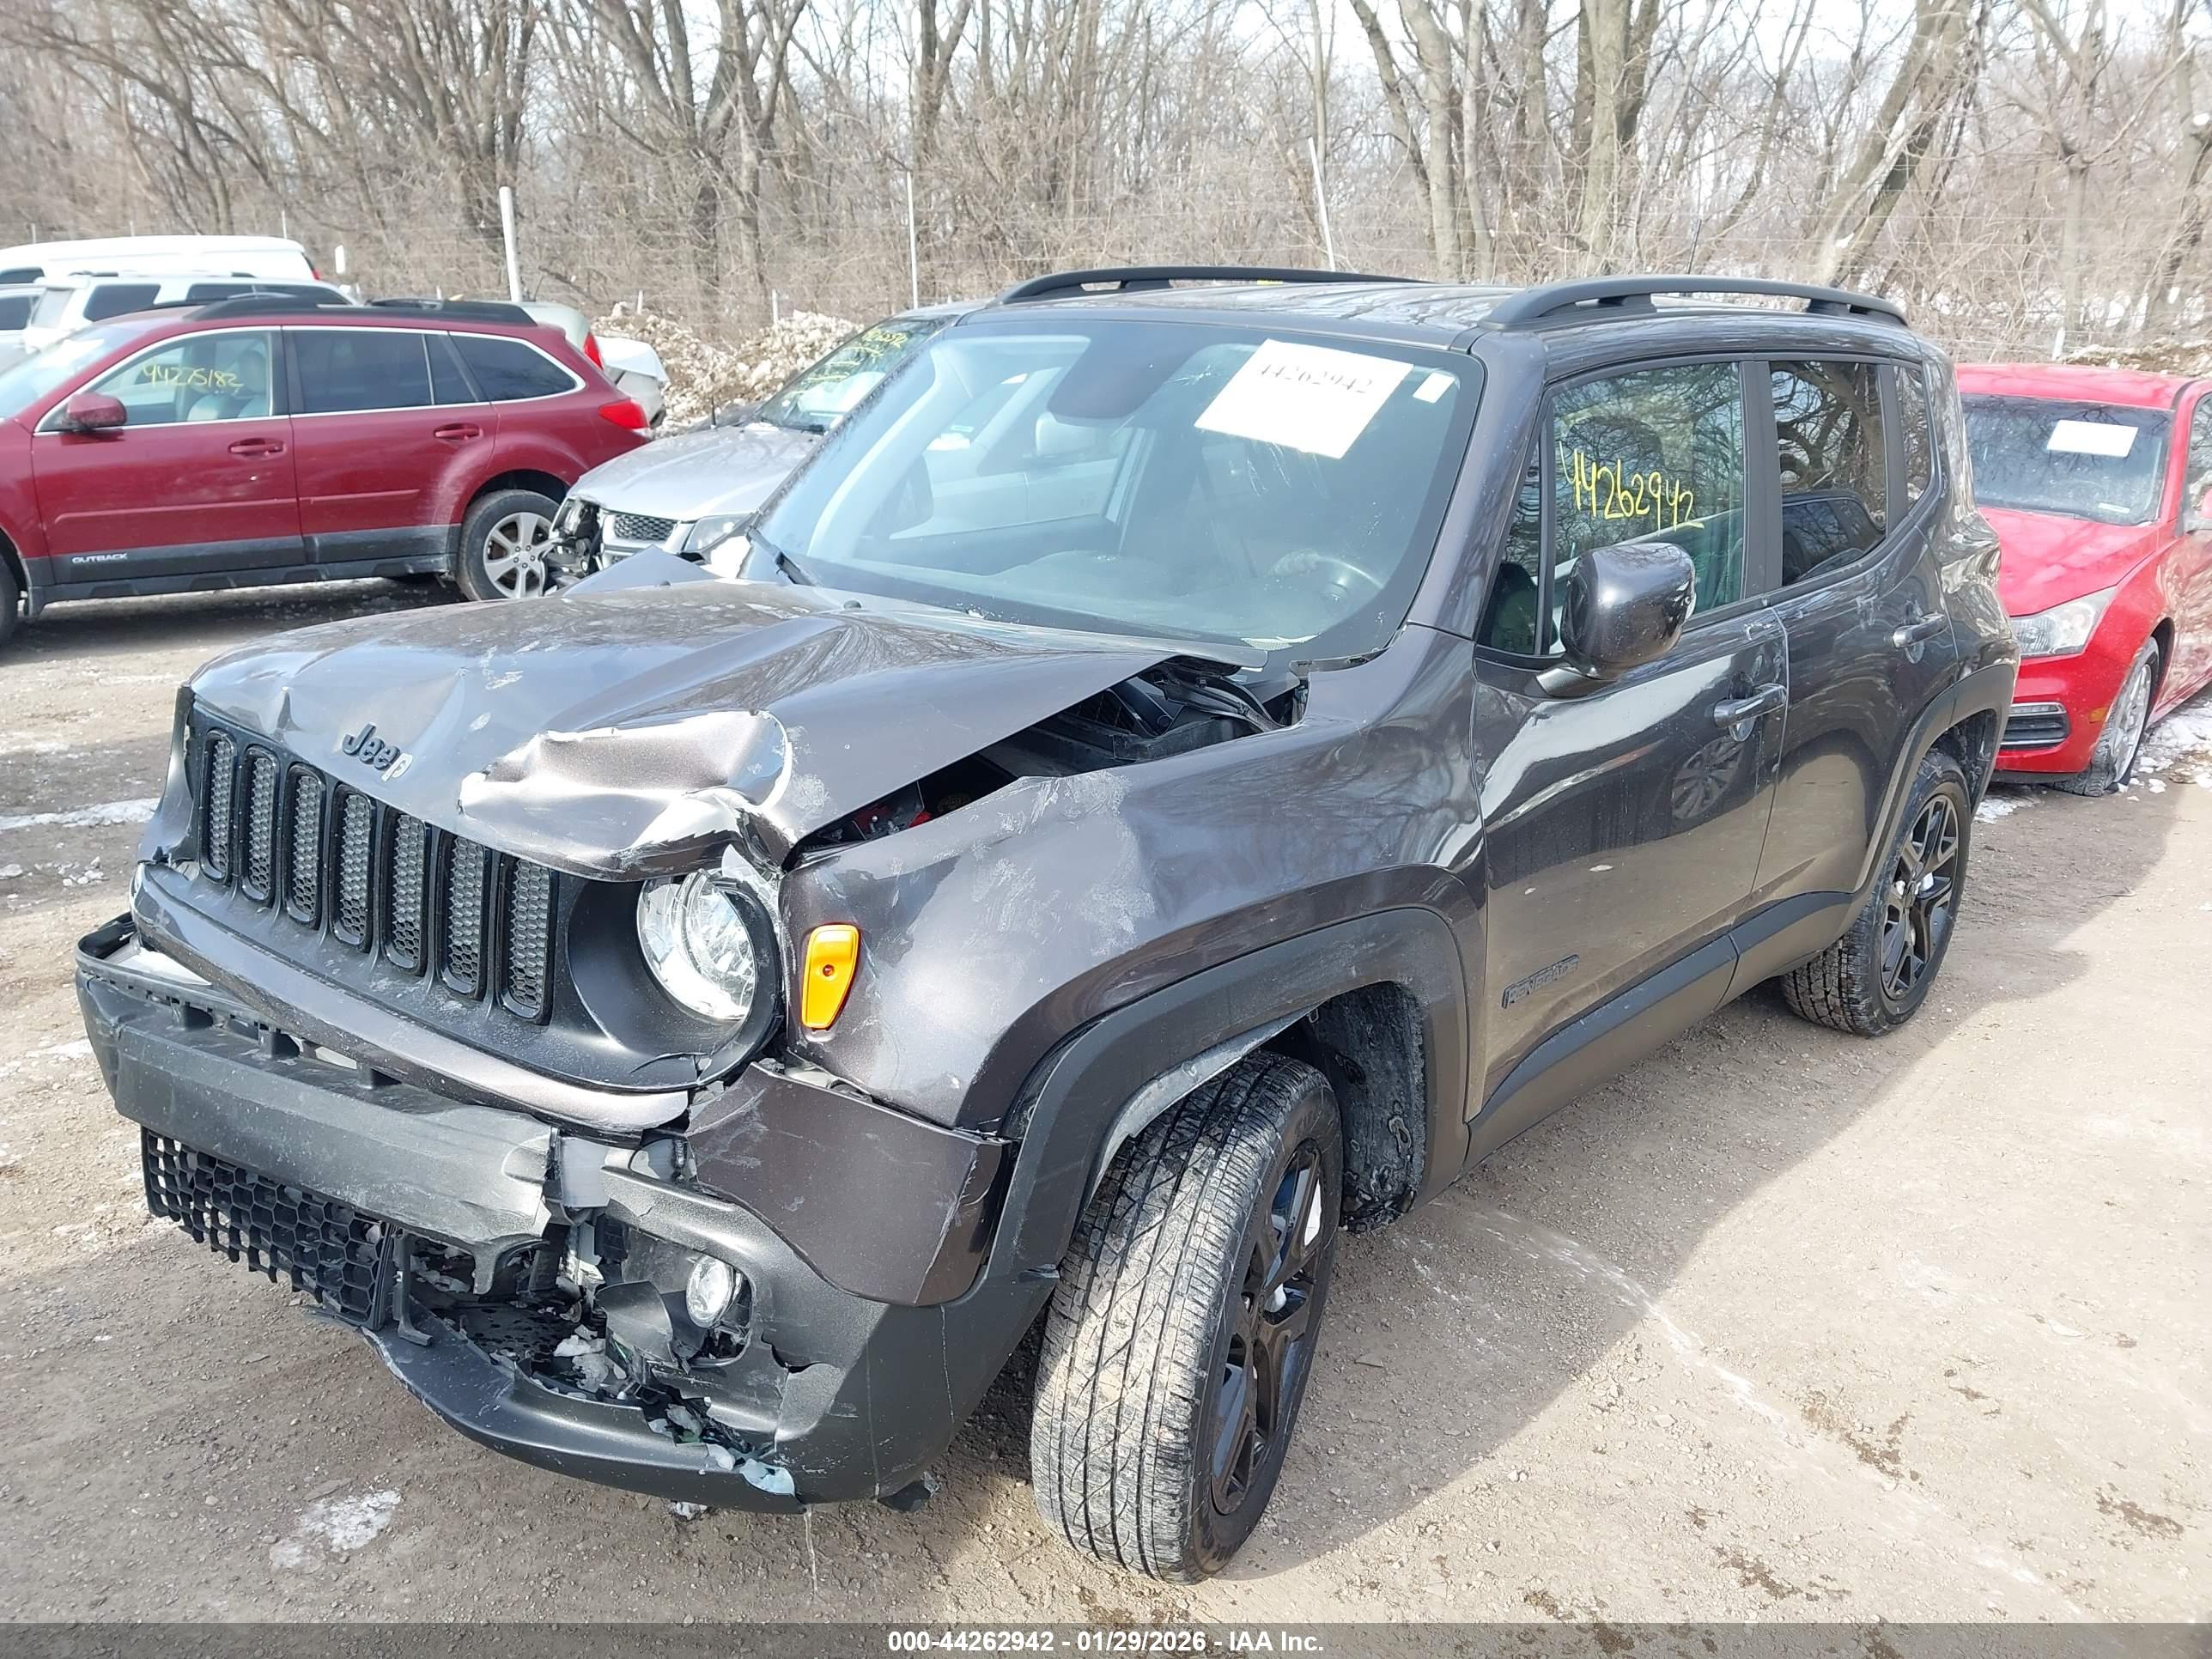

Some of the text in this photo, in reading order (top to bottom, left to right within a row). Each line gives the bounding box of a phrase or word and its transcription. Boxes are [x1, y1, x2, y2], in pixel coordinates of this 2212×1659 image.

[1559, 441, 1705, 537] 44262942
[71, 552, 128, 564] OUTBACK
[342, 721, 413, 782] Jeep
